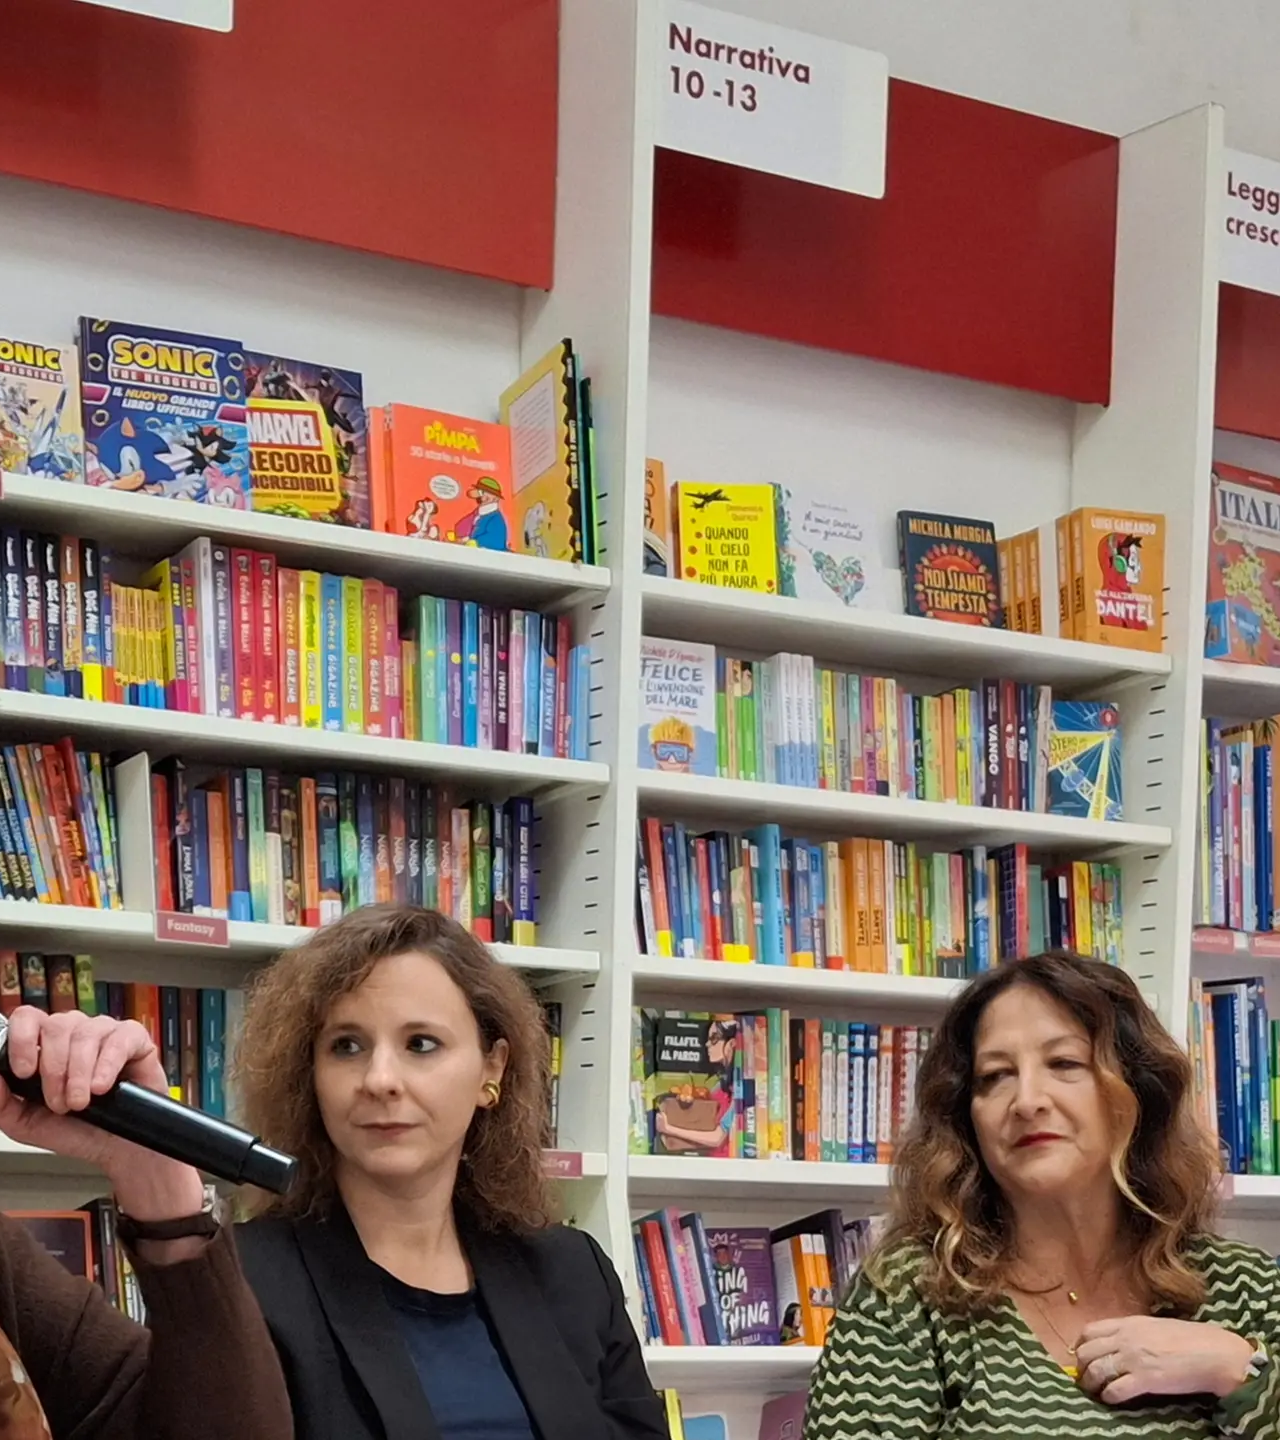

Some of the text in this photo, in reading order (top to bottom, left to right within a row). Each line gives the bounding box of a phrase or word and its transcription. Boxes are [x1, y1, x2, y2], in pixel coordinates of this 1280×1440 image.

[668, 23, 811, 84] Narrativa
[668, 65, 703, 101] 10
[111, 338, 215, 377] SONIC
[143, 373, 219, 393] HEDGEHOG
[112, 387, 216, 409] IL NUOVO GRANDE
[122, 400, 208, 419] LIBRO UFFICIALE
[246, 409, 320, 447] MARVEL
[248, 450, 332, 475] RECORD
[705, 527, 749, 540] QUANDO
[909, 517, 994, 544] MICHELA MURGIA
[1091, 516, 1156, 535] LUIGI GARLANDO
[705, 543, 750, 555] IL CIELO
[708, 559, 748, 571] NON FA
[700, 573, 758, 589] PIÙ PAURA
[924, 565, 987, 594] NOI SIAMO
[926, 588, 987, 615] TEMPESTA
[1096, 599, 1154, 624] DANTE!
[640, 657, 703, 682] FELICE
[666, 694, 699, 709] MARE
[988, 724, 999, 775] VANGO
[166, 918, 215, 938] Fantasy
[665, 1035, 701, 1048] FALAFEL
[661, 1050, 701, 1062] AL PARCO
